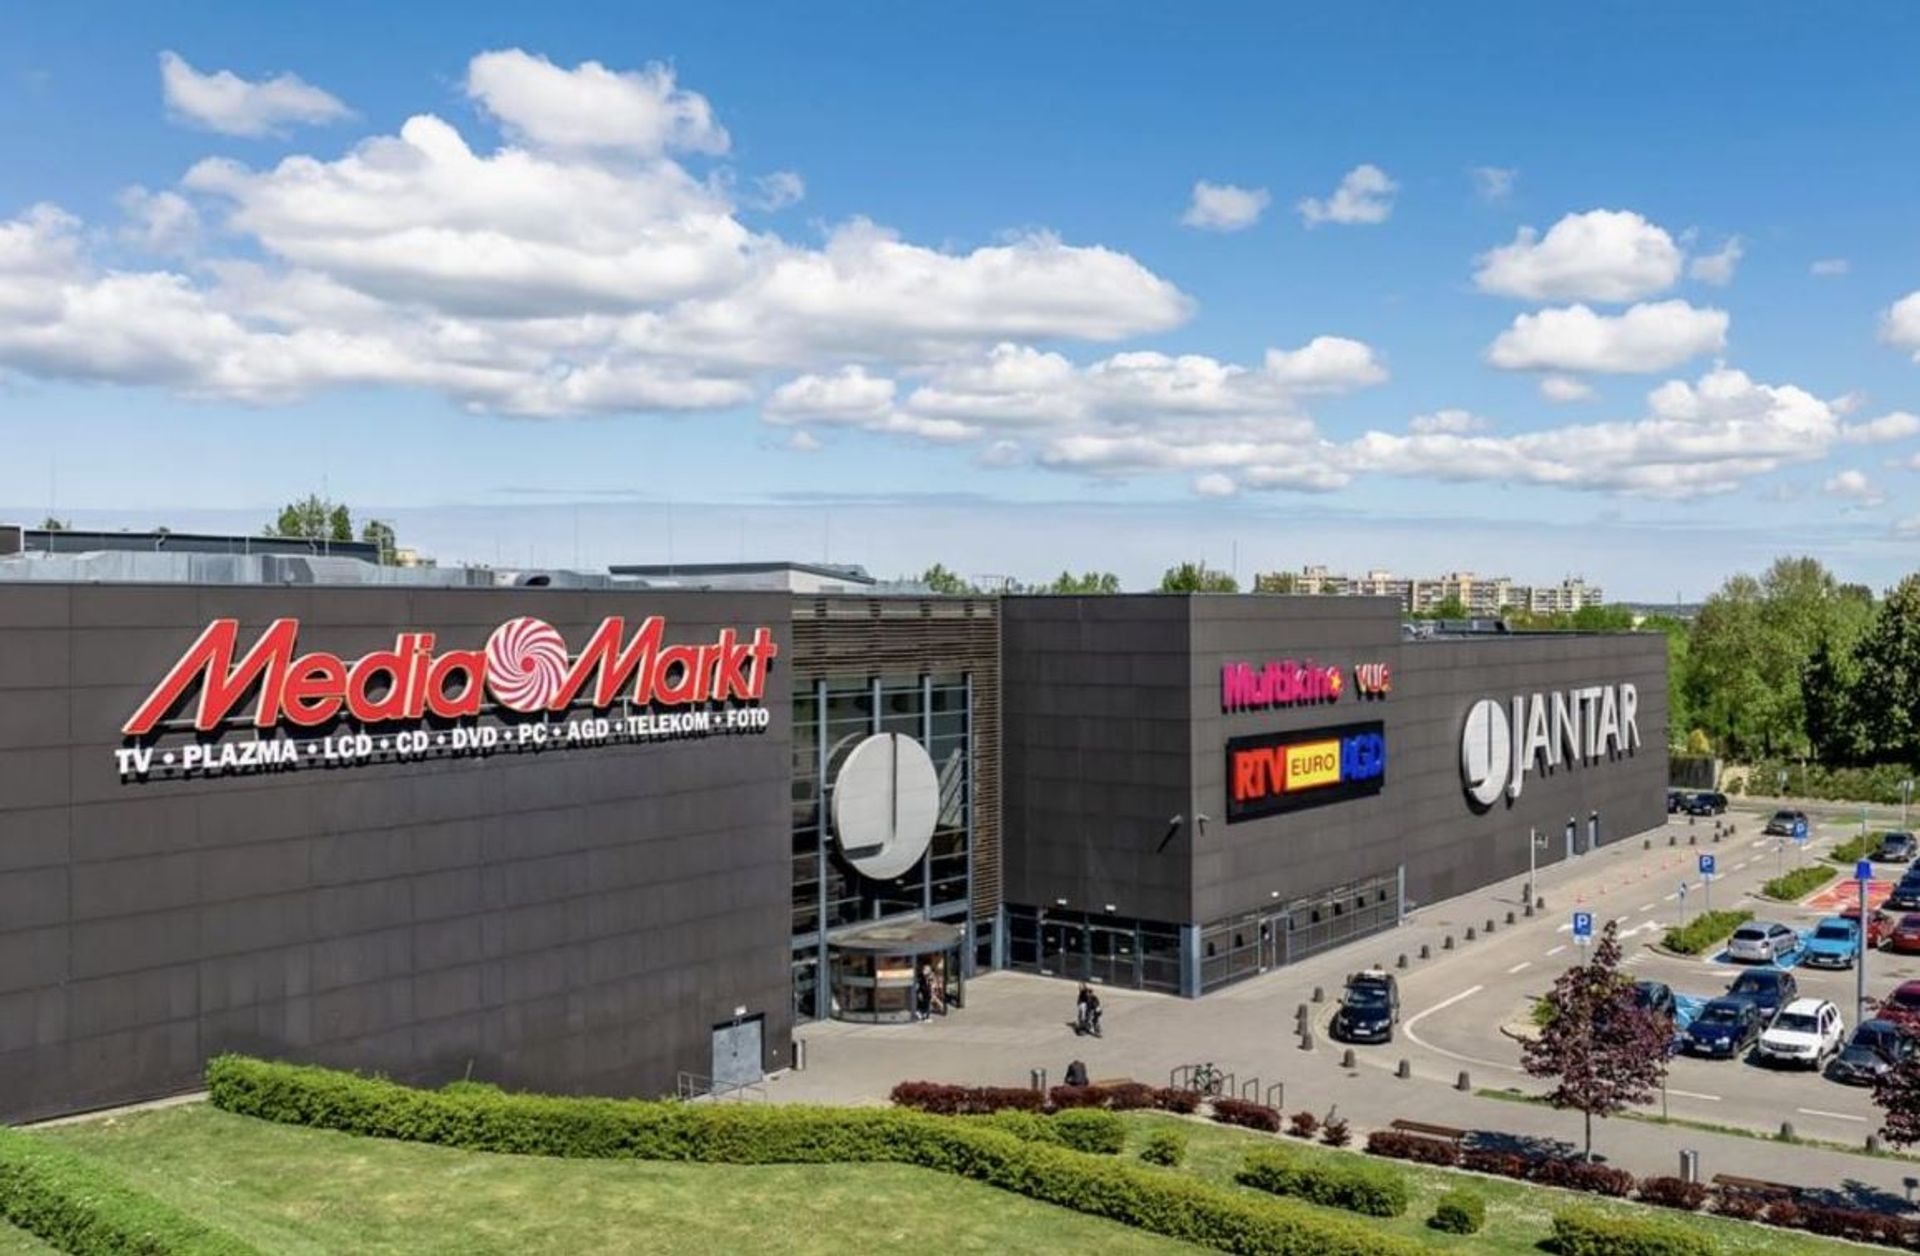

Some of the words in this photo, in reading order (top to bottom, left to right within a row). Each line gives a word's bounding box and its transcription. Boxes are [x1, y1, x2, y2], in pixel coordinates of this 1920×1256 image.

[121, 617, 489, 735] Media
[549, 615, 778, 711] Markt
[1222, 660, 1343, 708] Multikino
[115, 747, 153, 773] TV
[183, 739, 298, 768] PLAZMA
[324, 734, 372, 759] LCD
[396, 730, 429, 752] CD
[452, 727, 497, 749] DVD
[518, 723, 547, 744] PC
[567, 719, 609, 740] AGD
[628, 711, 710, 735] TELEKOM
[727, 707, 769, 727] FOTO
[1233, 745, 1286, 800] RTV
[1291, 754, 1336, 776] EURO
[1508, 683, 1641, 798] JANTAR
